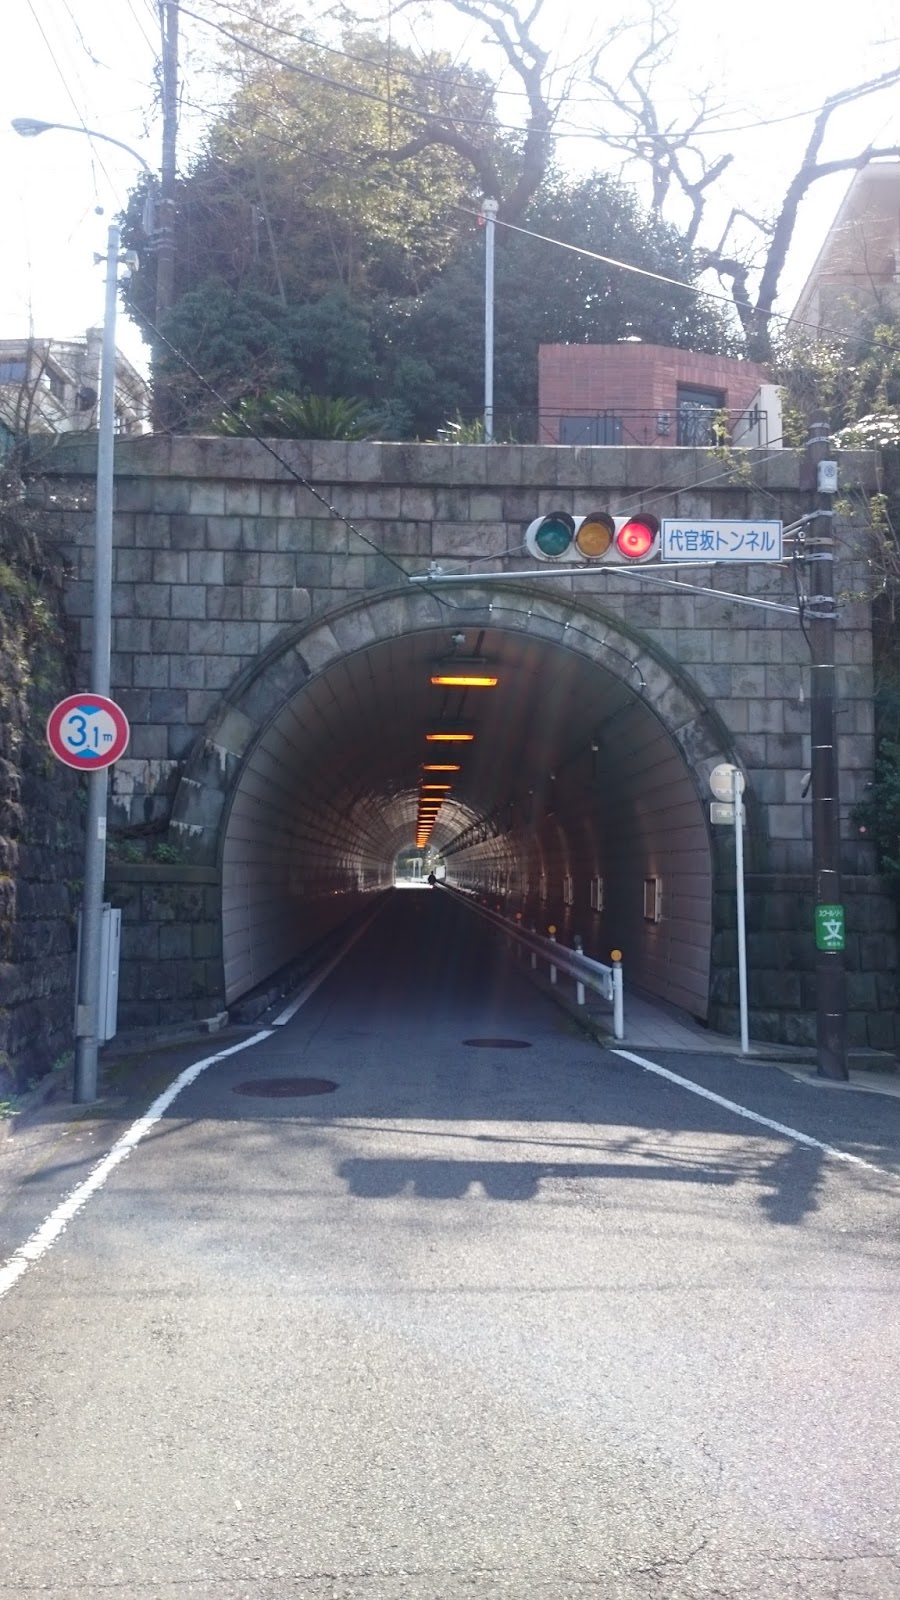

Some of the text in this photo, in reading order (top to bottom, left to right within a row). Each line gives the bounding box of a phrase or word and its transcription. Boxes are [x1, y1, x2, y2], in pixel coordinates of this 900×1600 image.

[669, 529, 775, 552] 代官坂トンネル
[822, 918, 843, 941] 文
